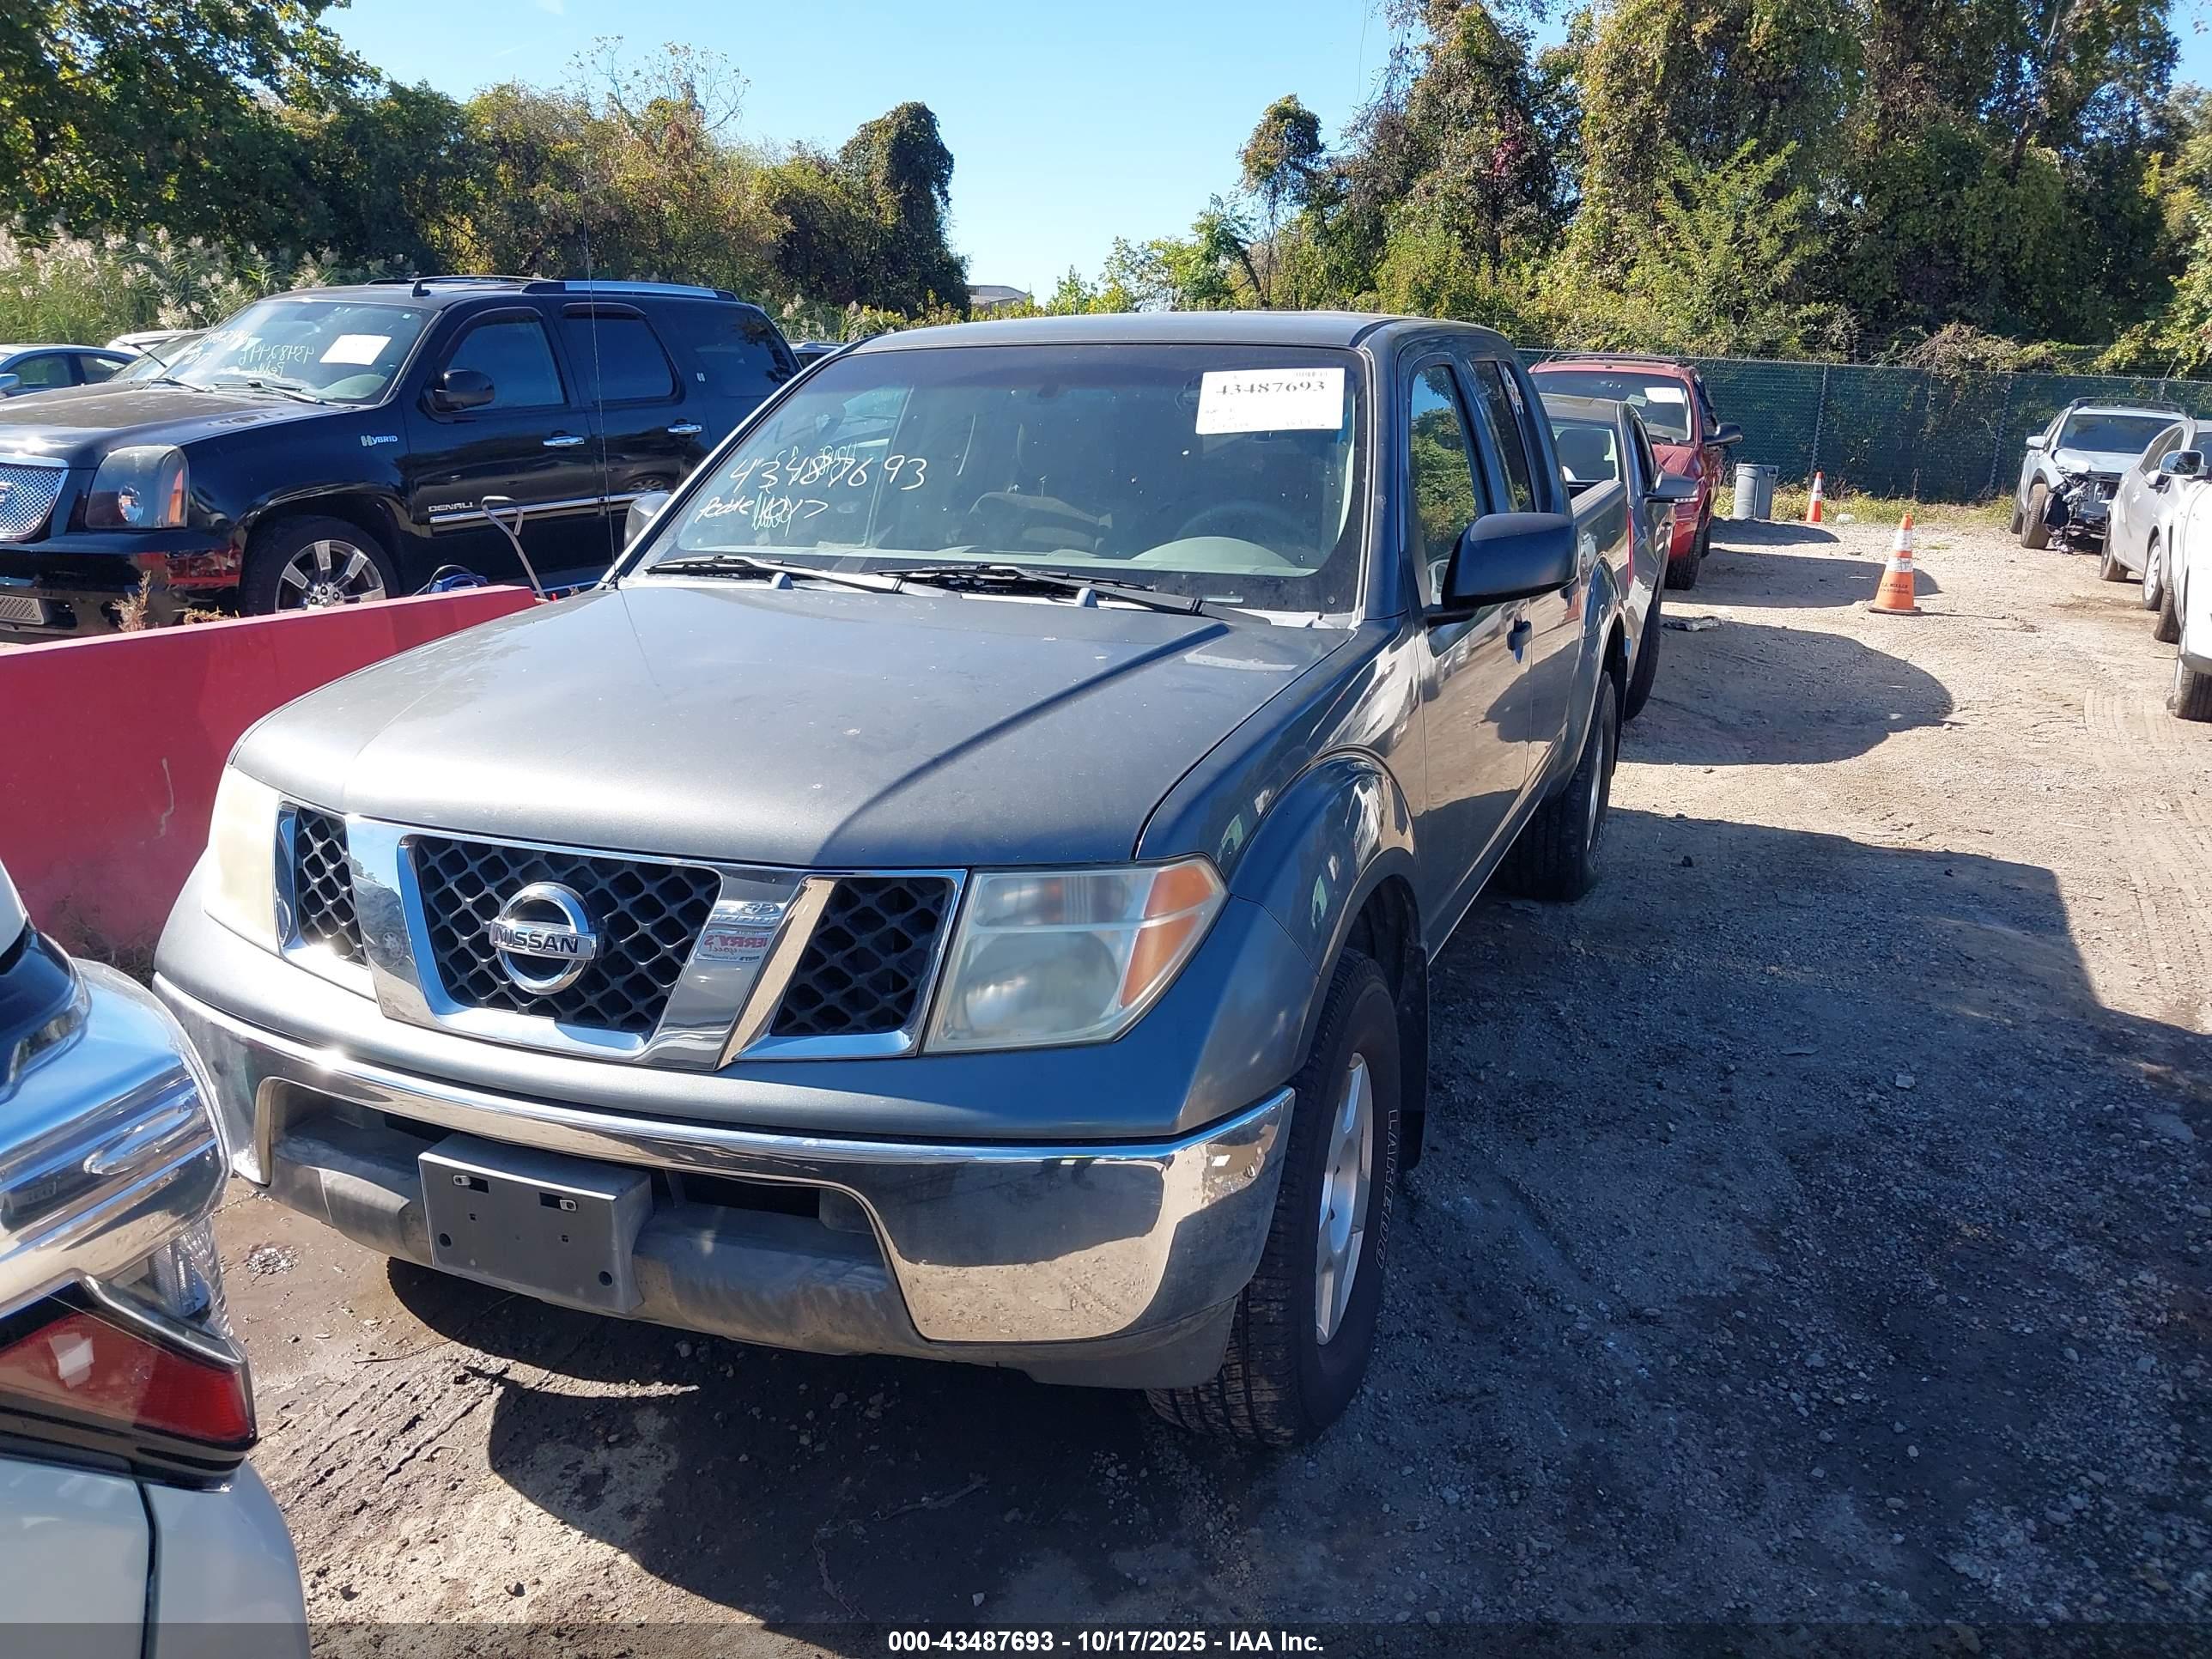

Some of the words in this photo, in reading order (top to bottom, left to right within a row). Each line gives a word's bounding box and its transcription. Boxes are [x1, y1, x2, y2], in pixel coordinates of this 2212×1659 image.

[1216, 380, 1325, 395] 43487693
[360, 434, 398, 447] HYBRID
[730, 453, 927, 493] 43487693
[428, 501, 473, 513] DENALI
[494, 927, 579, 953] NISSAN
[1376, 1109, 1400, 1271] LAREDO
